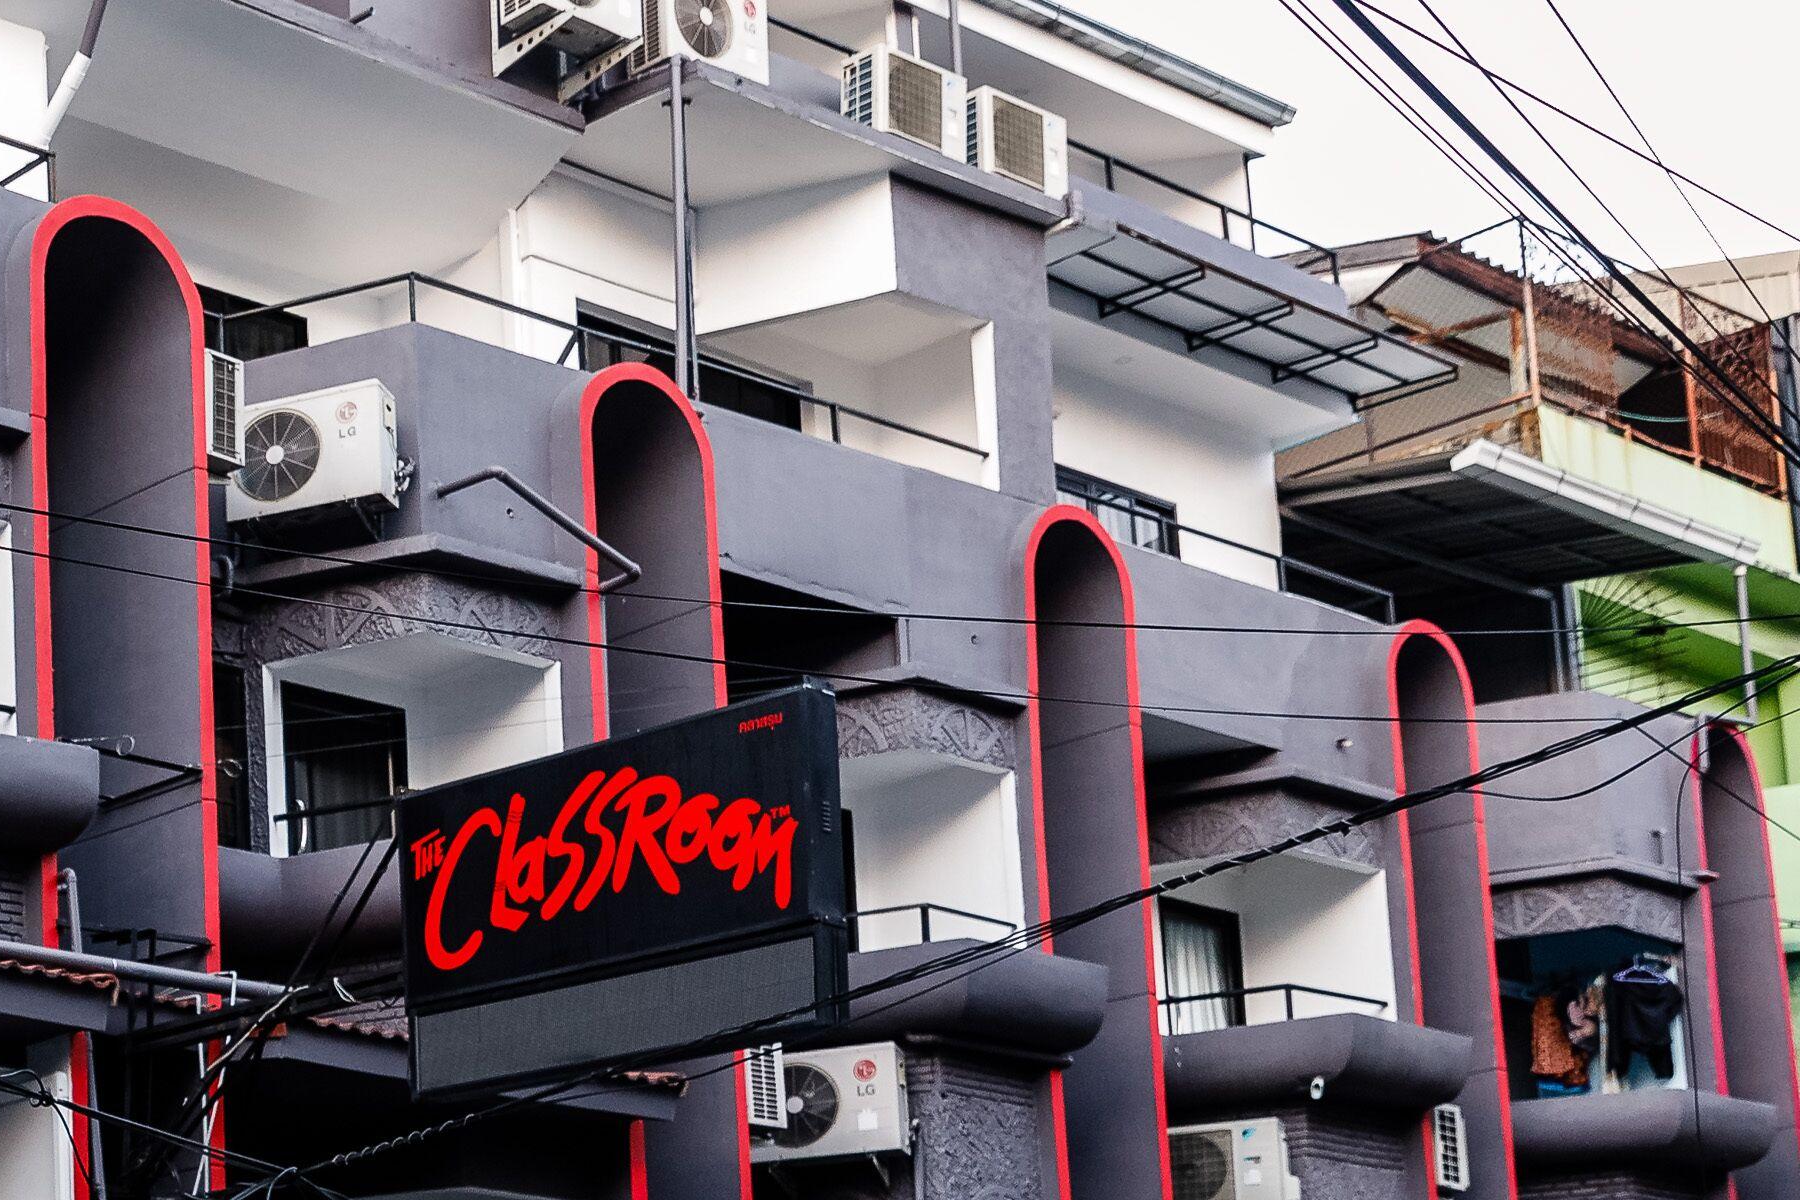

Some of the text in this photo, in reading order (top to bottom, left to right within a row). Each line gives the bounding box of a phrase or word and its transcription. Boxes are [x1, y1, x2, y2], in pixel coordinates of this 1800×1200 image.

[338, 426, 357, 439] LG
[410, 827, 447, 882] THE
[856, 1084, 876, 1097] LG
